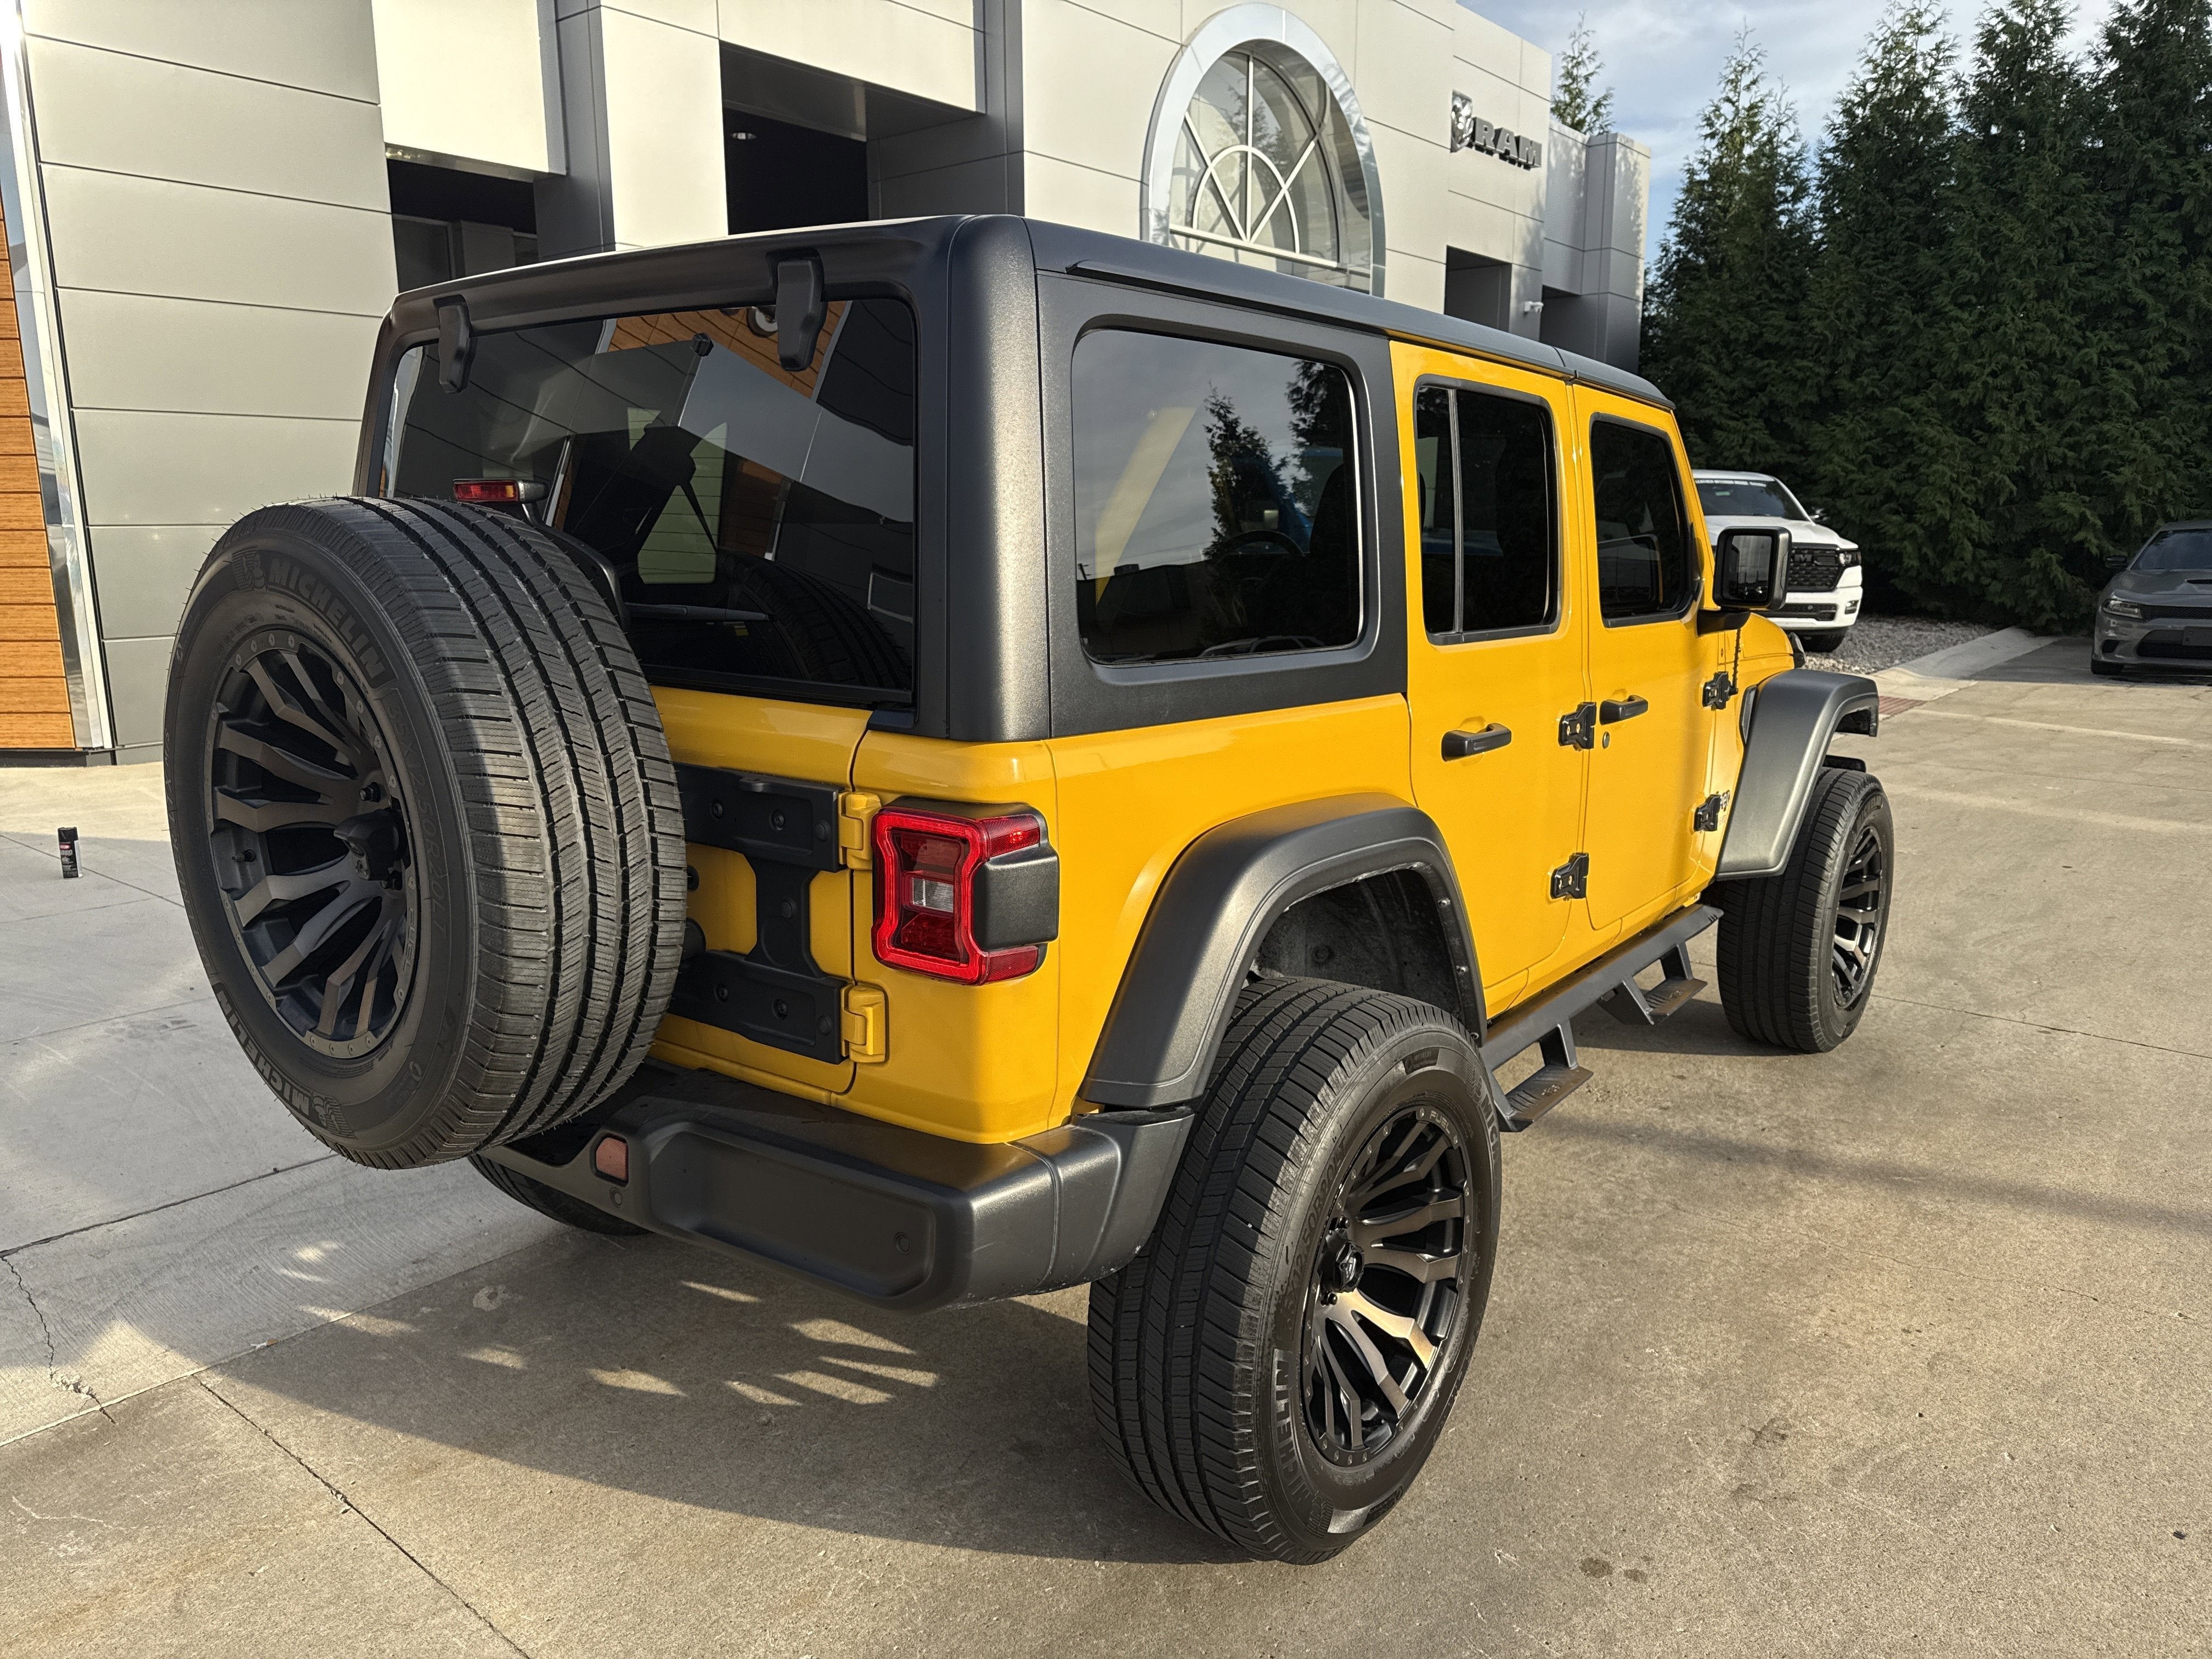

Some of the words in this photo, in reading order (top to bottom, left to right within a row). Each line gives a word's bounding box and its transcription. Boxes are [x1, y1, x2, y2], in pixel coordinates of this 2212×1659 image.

[1473, 116, 1542, 168] RAM
[269, 558, 385, 684] MICHELIN
[216, 990, 310, 1117] MICHELIN
[1429, 1109, 1451, 1135] FUEL
[1276, 1360, 1312, 1503] MICHELIN
